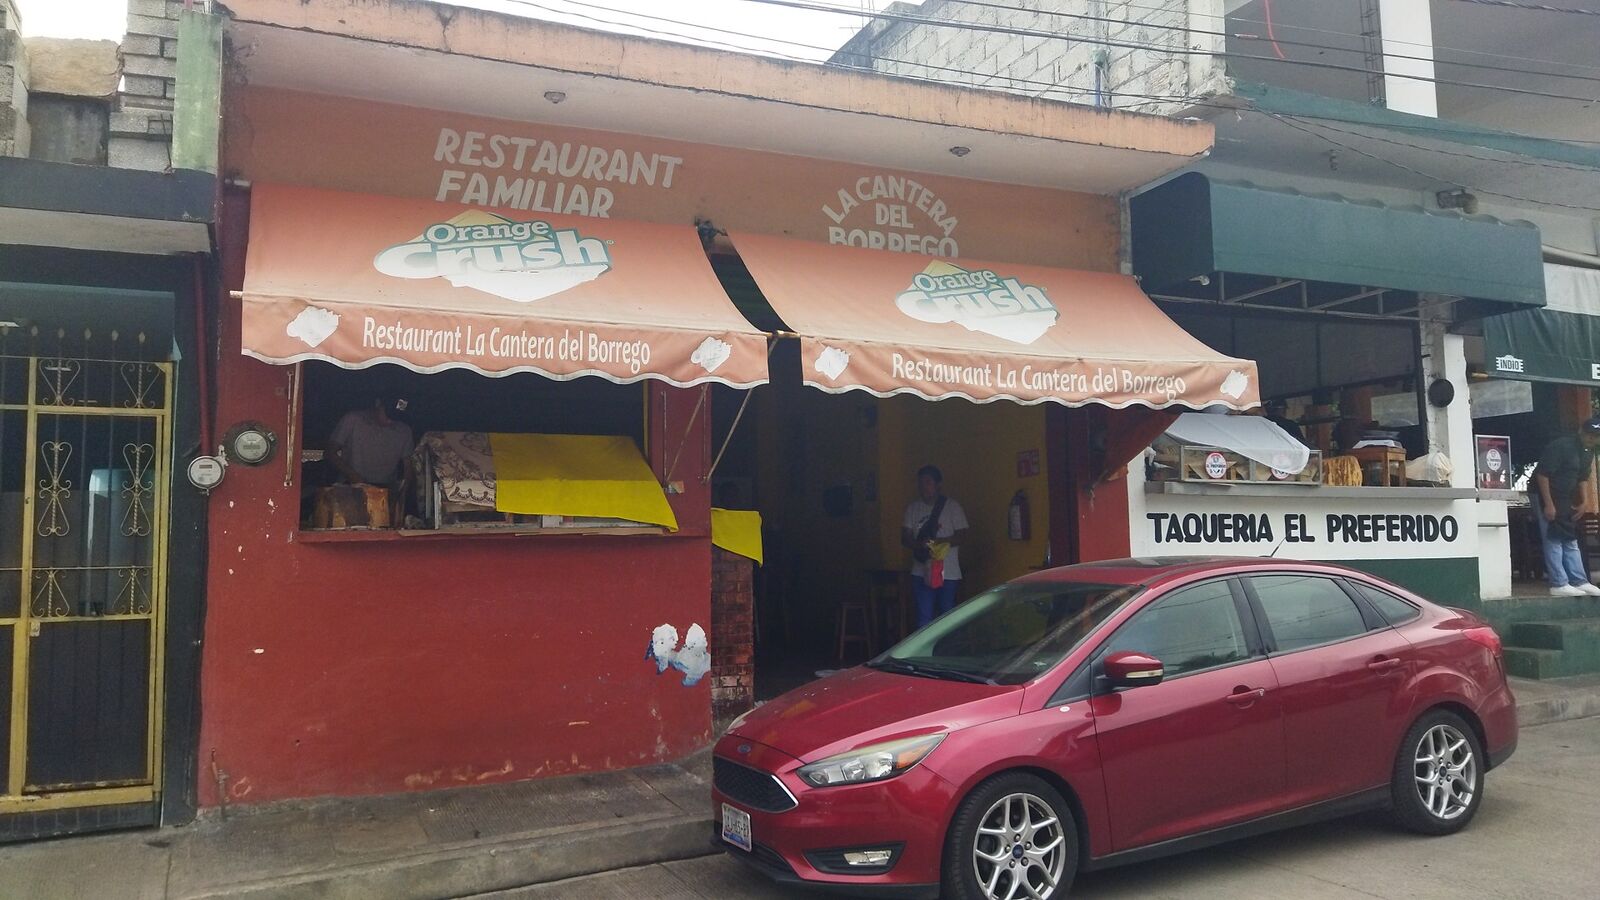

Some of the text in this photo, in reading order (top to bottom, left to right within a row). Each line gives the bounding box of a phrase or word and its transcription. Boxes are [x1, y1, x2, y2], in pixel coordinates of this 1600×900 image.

[433, 127, 683, 189] RESTAURANT
[435, 169, 615, 218] FAMILIAR
[822, 175, 959, 236] LA CANTERA
[876, 202, 914, 229] DEL
[426, 220, 550, 244] Orange
[914, 270, 998, 292] Orange
[362, 316, 651, 374] Restaurant La Cantera del Borrego
[892, 353, 1187, 400] Restaurant La Cantera del Borrego
[1146, 513, 1459, 543] TAQUERIA EL PREFERIDO
